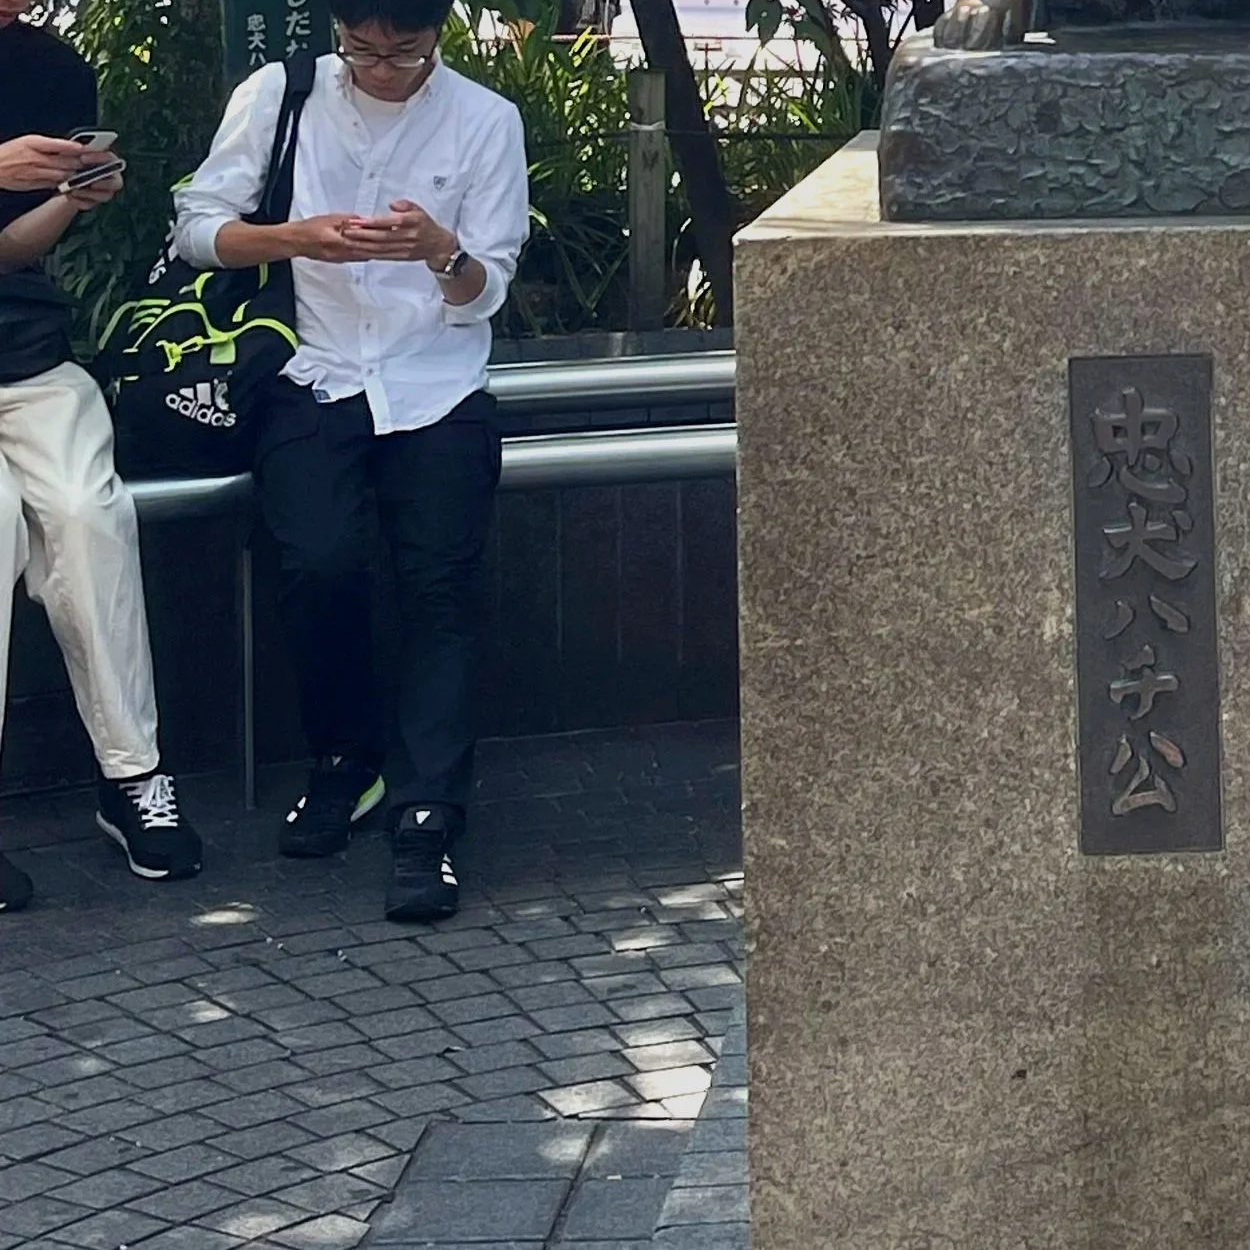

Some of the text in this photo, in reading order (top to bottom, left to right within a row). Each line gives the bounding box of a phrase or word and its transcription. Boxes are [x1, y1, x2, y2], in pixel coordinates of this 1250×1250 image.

[165, 392, 237, 428] adidas
[1088, 386, 1199, 817] 忠犬ハチ公
